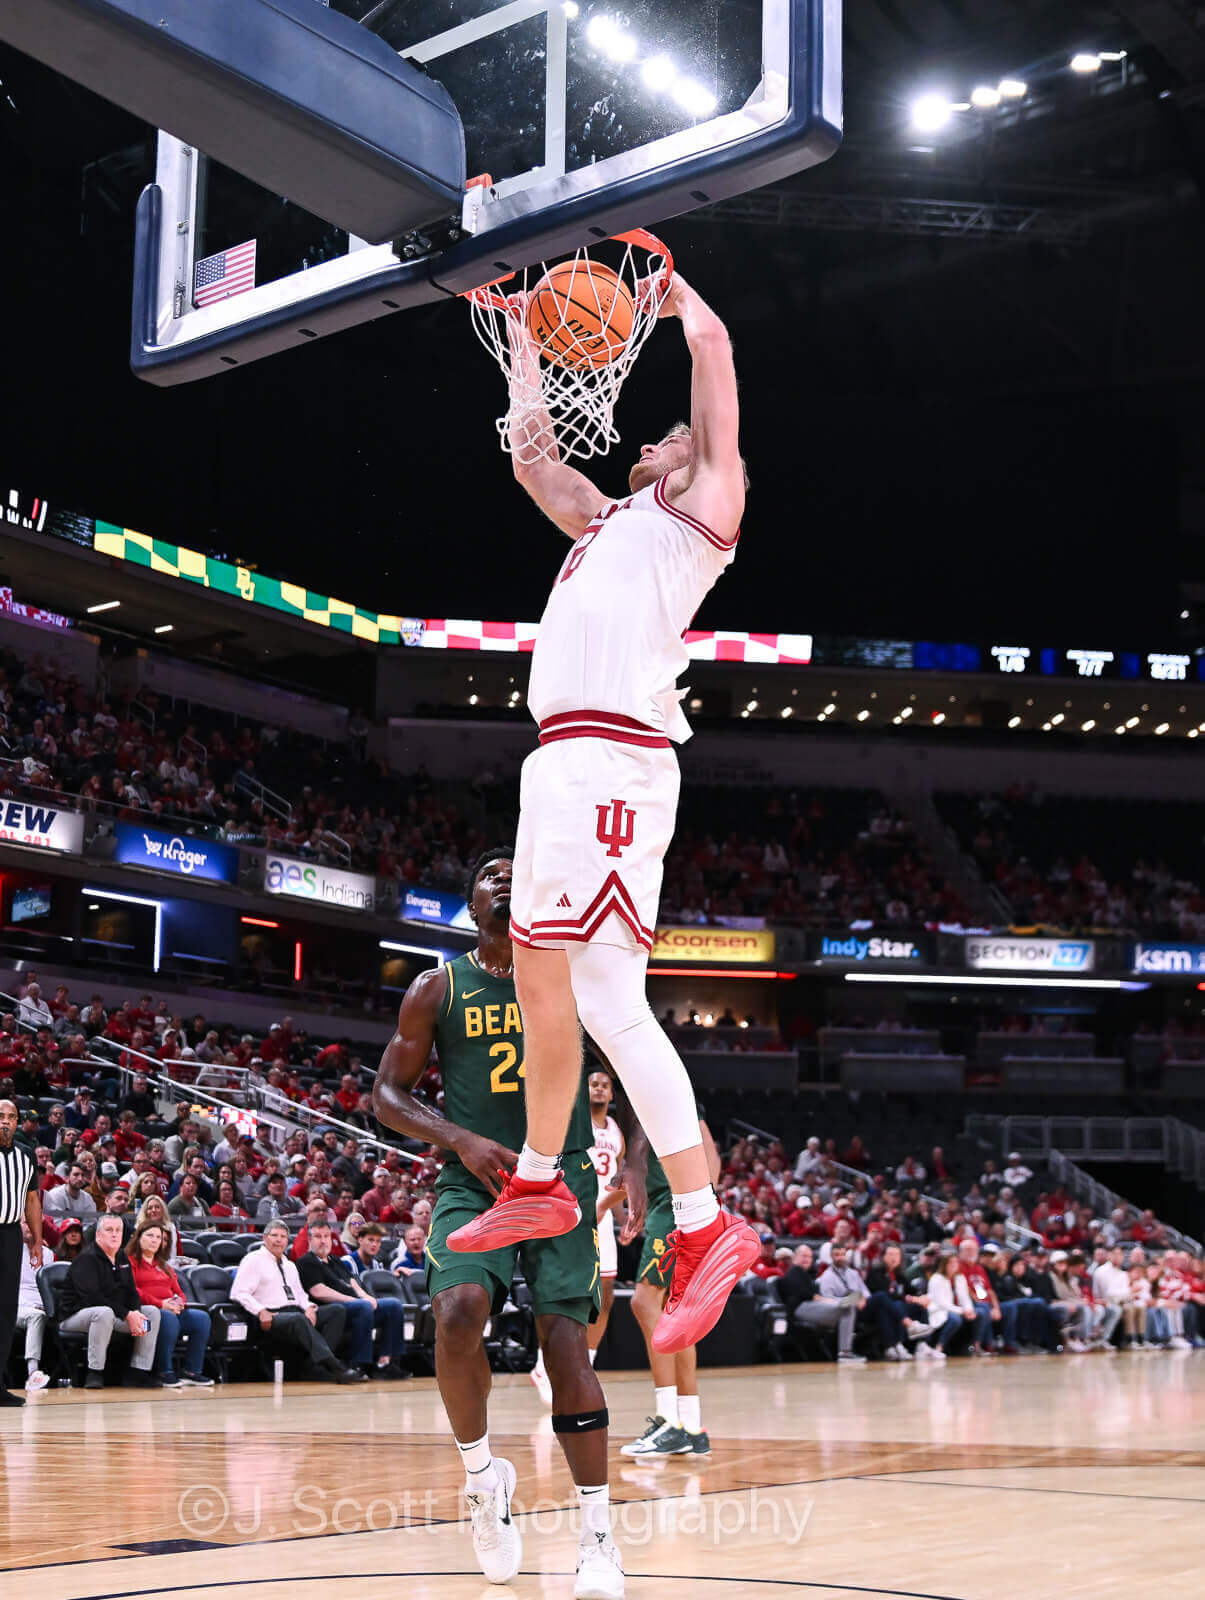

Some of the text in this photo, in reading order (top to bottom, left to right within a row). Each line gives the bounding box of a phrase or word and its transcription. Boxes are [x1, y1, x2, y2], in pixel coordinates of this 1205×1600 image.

[0, 801, 57, 834] EW
[163, 837, 208, 874] Kroger
[267, 860, 374, 908] aes Indiana
[654, 930, 758, 949] Koorsen
[822, 936, 920, 960] IndyStar.
[968, 943, 1053, 961] SECTION
[1134, 943, 1192, 972] ksm
[464, 1002, 523, 1038] BEA
[488, 1041, 527, 1094] 2
